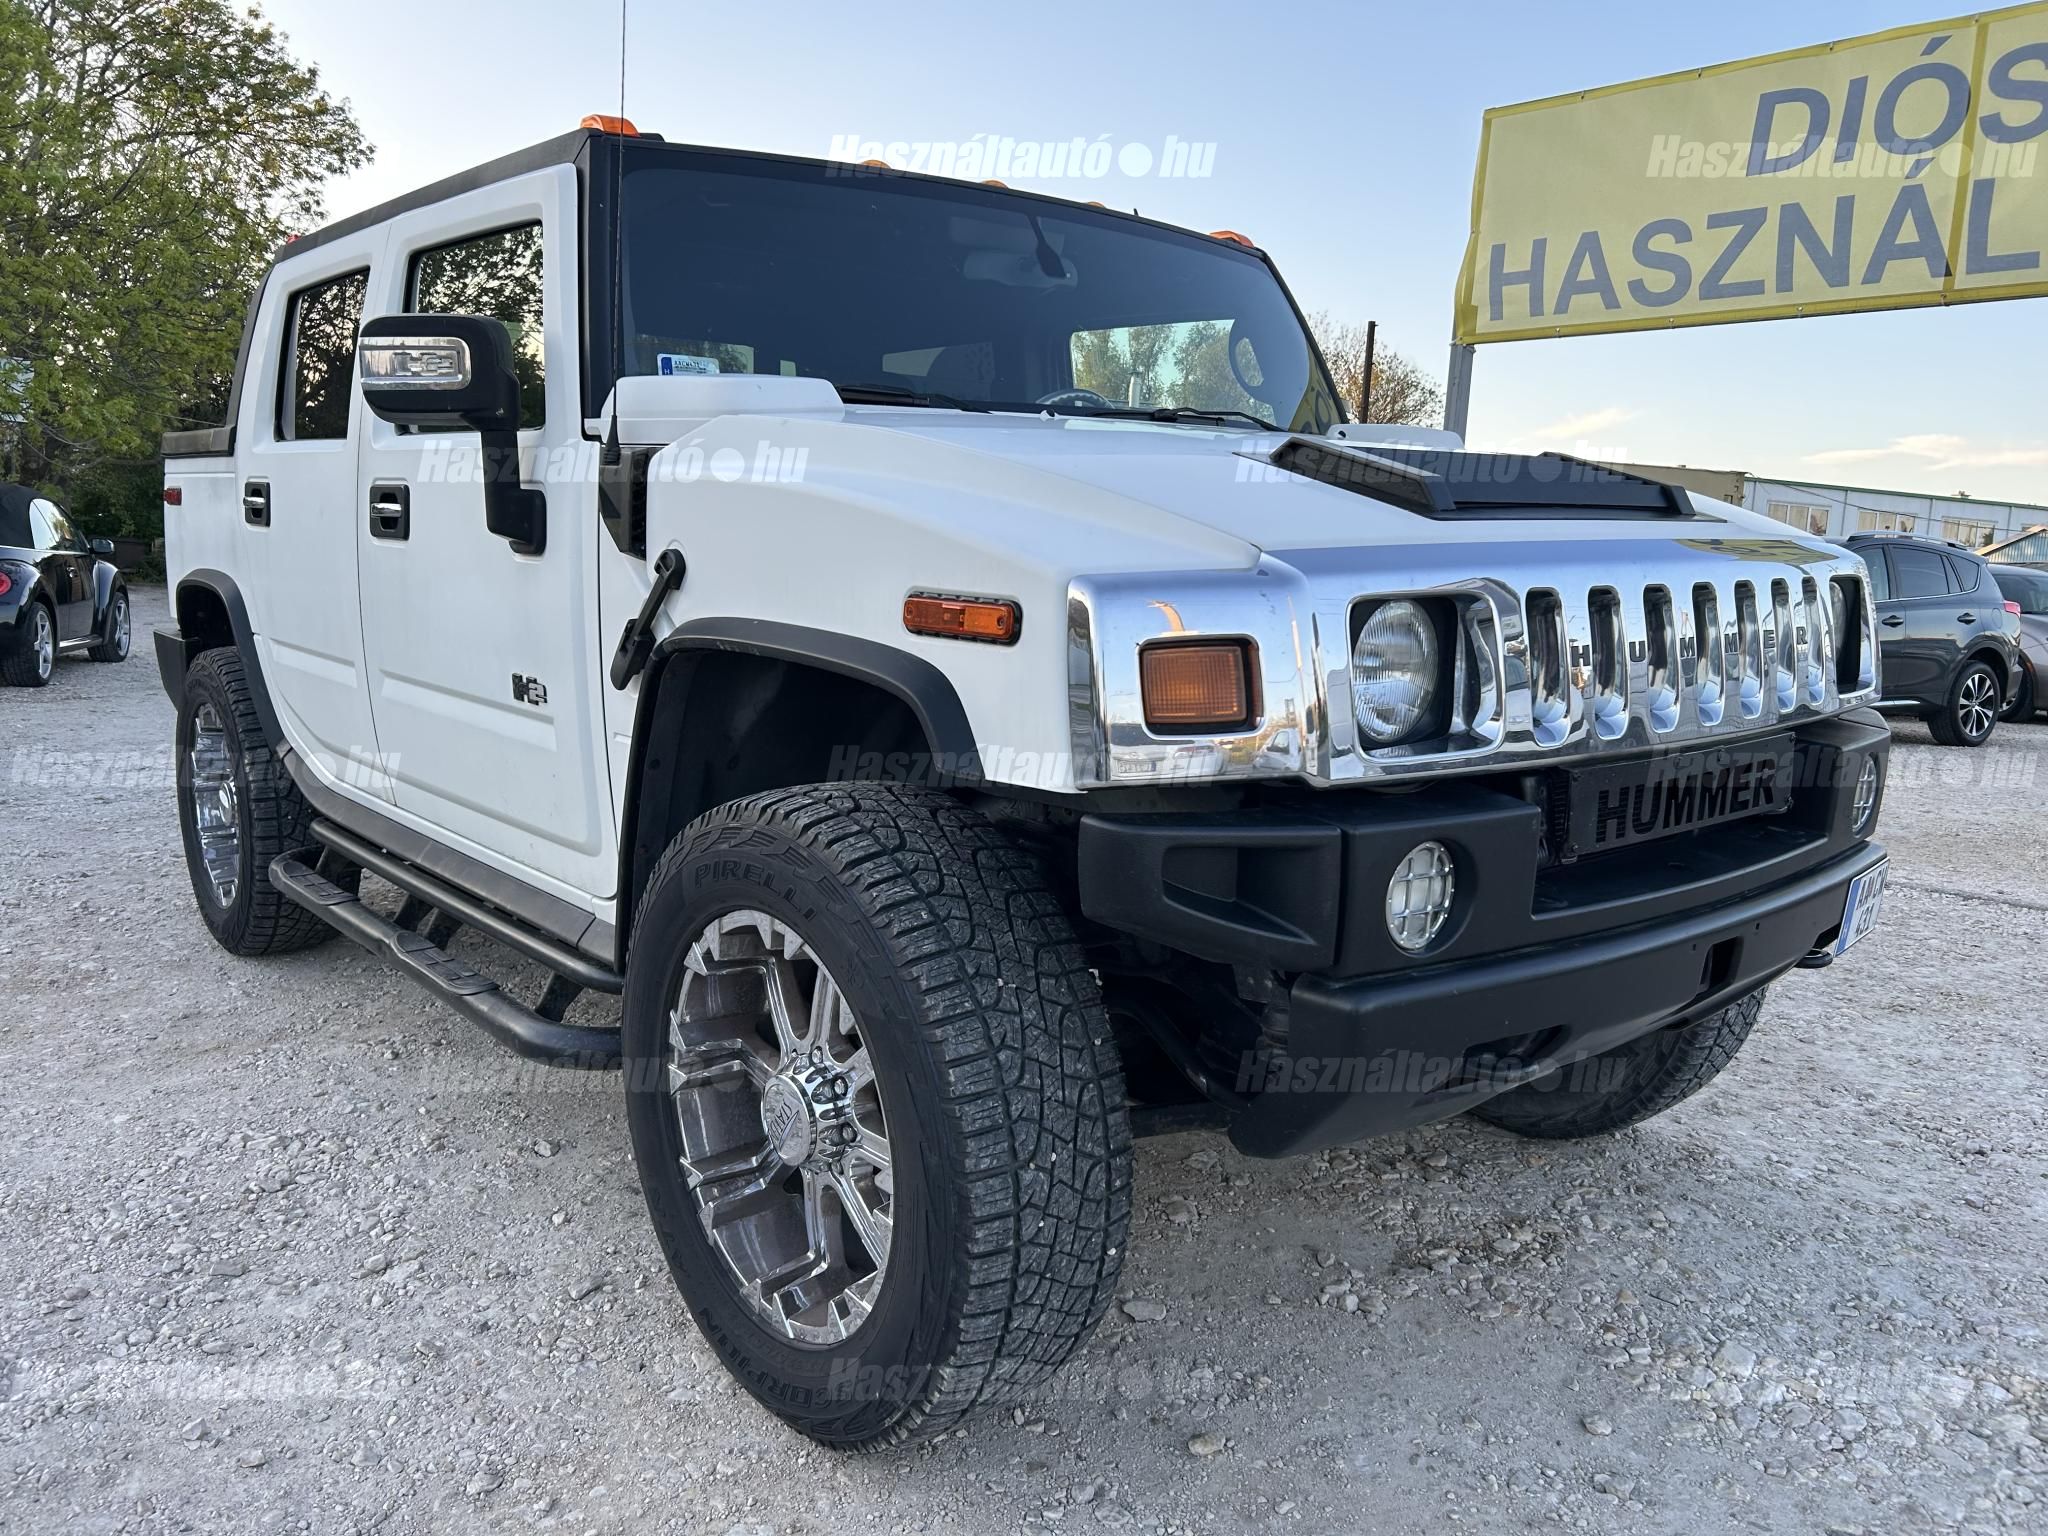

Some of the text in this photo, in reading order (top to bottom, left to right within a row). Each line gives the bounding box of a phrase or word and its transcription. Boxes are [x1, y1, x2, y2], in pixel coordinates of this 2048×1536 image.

[1489, 157, 2040, 322] HASZNÁL
[1571, 626, 1808, 667] HUMMER
[512, 673, 547, 706] H2
[1596, 758, 1776, 843] HUMMER
[694, 859, 817, 921] PIRELLI
